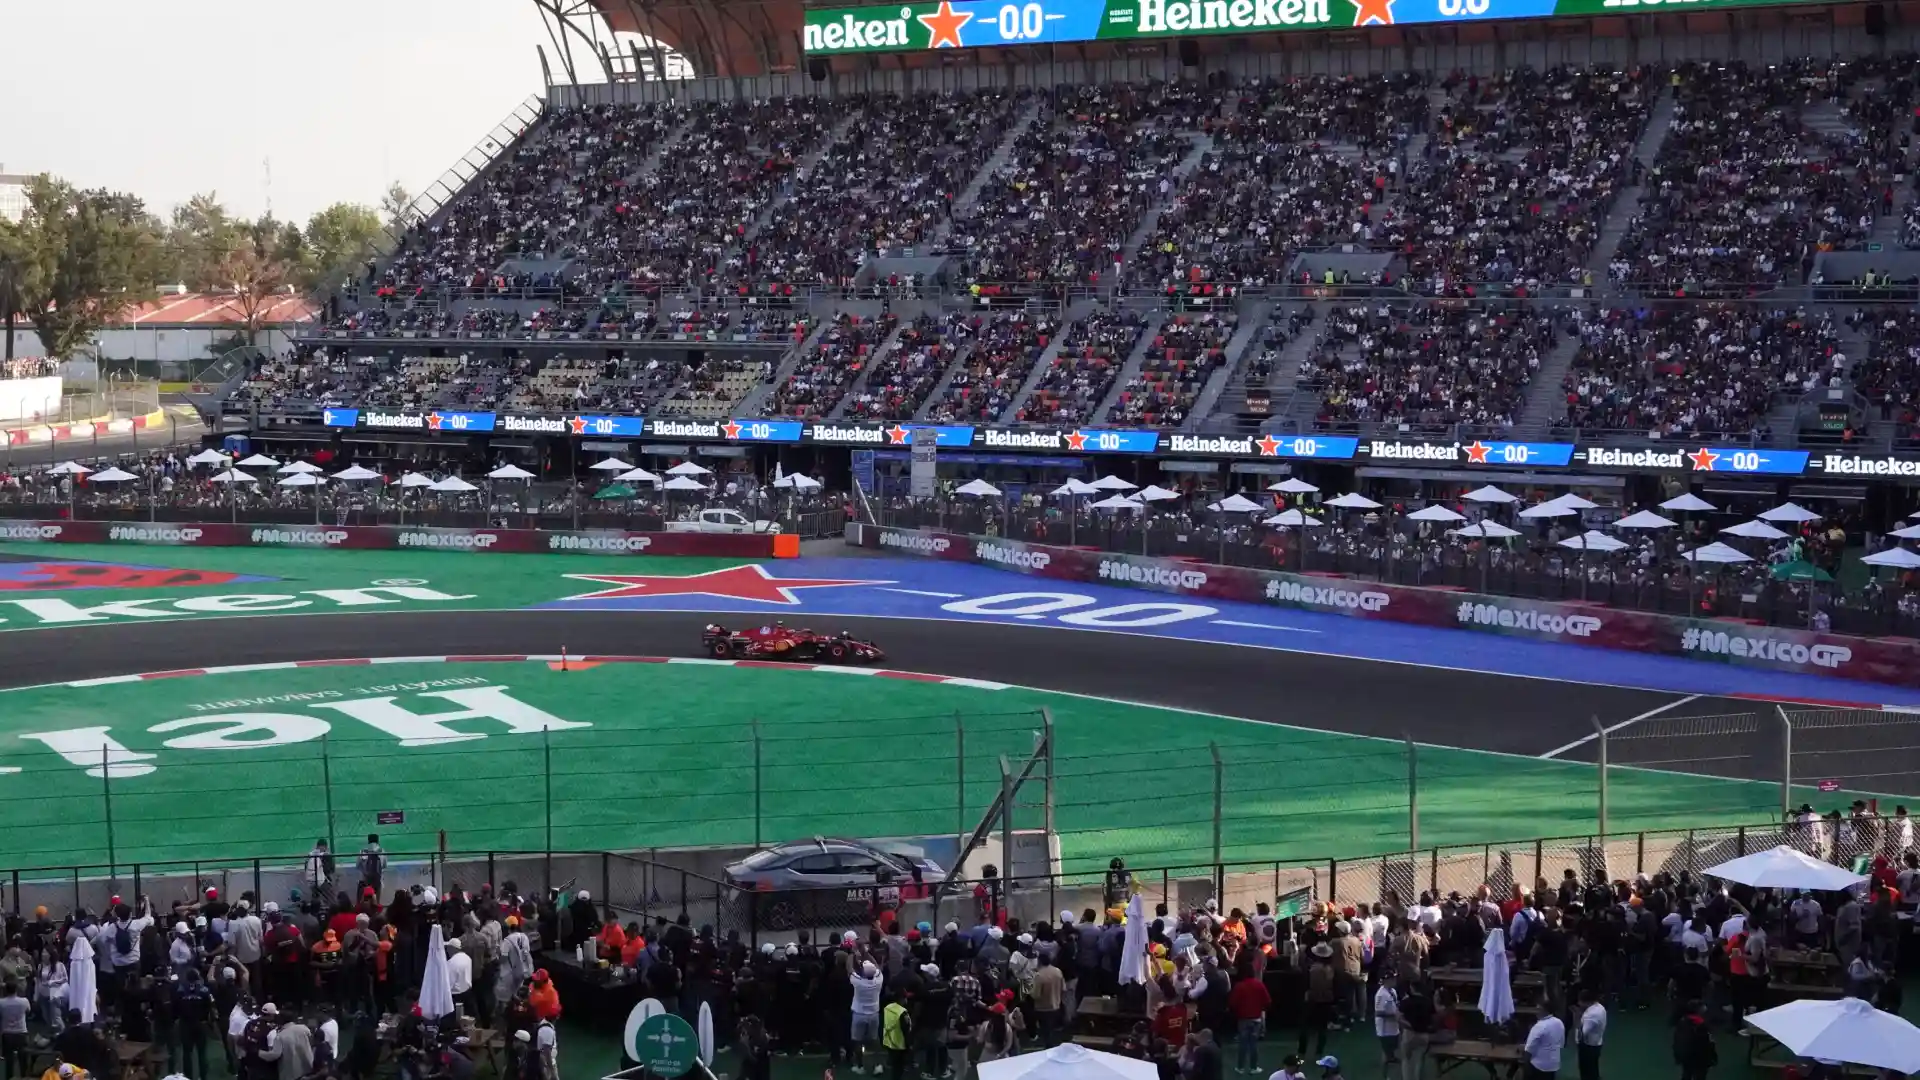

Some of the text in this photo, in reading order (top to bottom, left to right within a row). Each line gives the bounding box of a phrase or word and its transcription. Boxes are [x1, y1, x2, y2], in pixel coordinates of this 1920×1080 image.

[1138, 0, 1330, 32] Heineken
[367, 408, 423, 427] Heineken
[505, 416, 566, 431] Heineken
[654, 421, 719, 436] Heineken
[813, 426, 884, 441] Heineken
[985, 430, 1061, 447] Heineken
[1171, 436, 1253, 453] Heineken
[1371, 441, 1460, 459] Heineken
[1588, 448, 1684, 467] Heineken
[110, 524, 202, 541] #MexicoGP
[252, 530, 348, 544] #MexicoGP
[398, 530, 497, 547] #MexicoGP
[880, 531, 950, 551] #MexicoGP
[550, 532, 651, 553] #MexicoGP
[976, 541, 1050, 569] #MexicoGP
[1099, 560, 1206, 588] #MexicoGP
[1266, 579, 1389, 611] #MexicoGP
[1457, 602, 1601, 636] #MexicoGP
[1681, 628, 1852, 668] #MexicoGP
